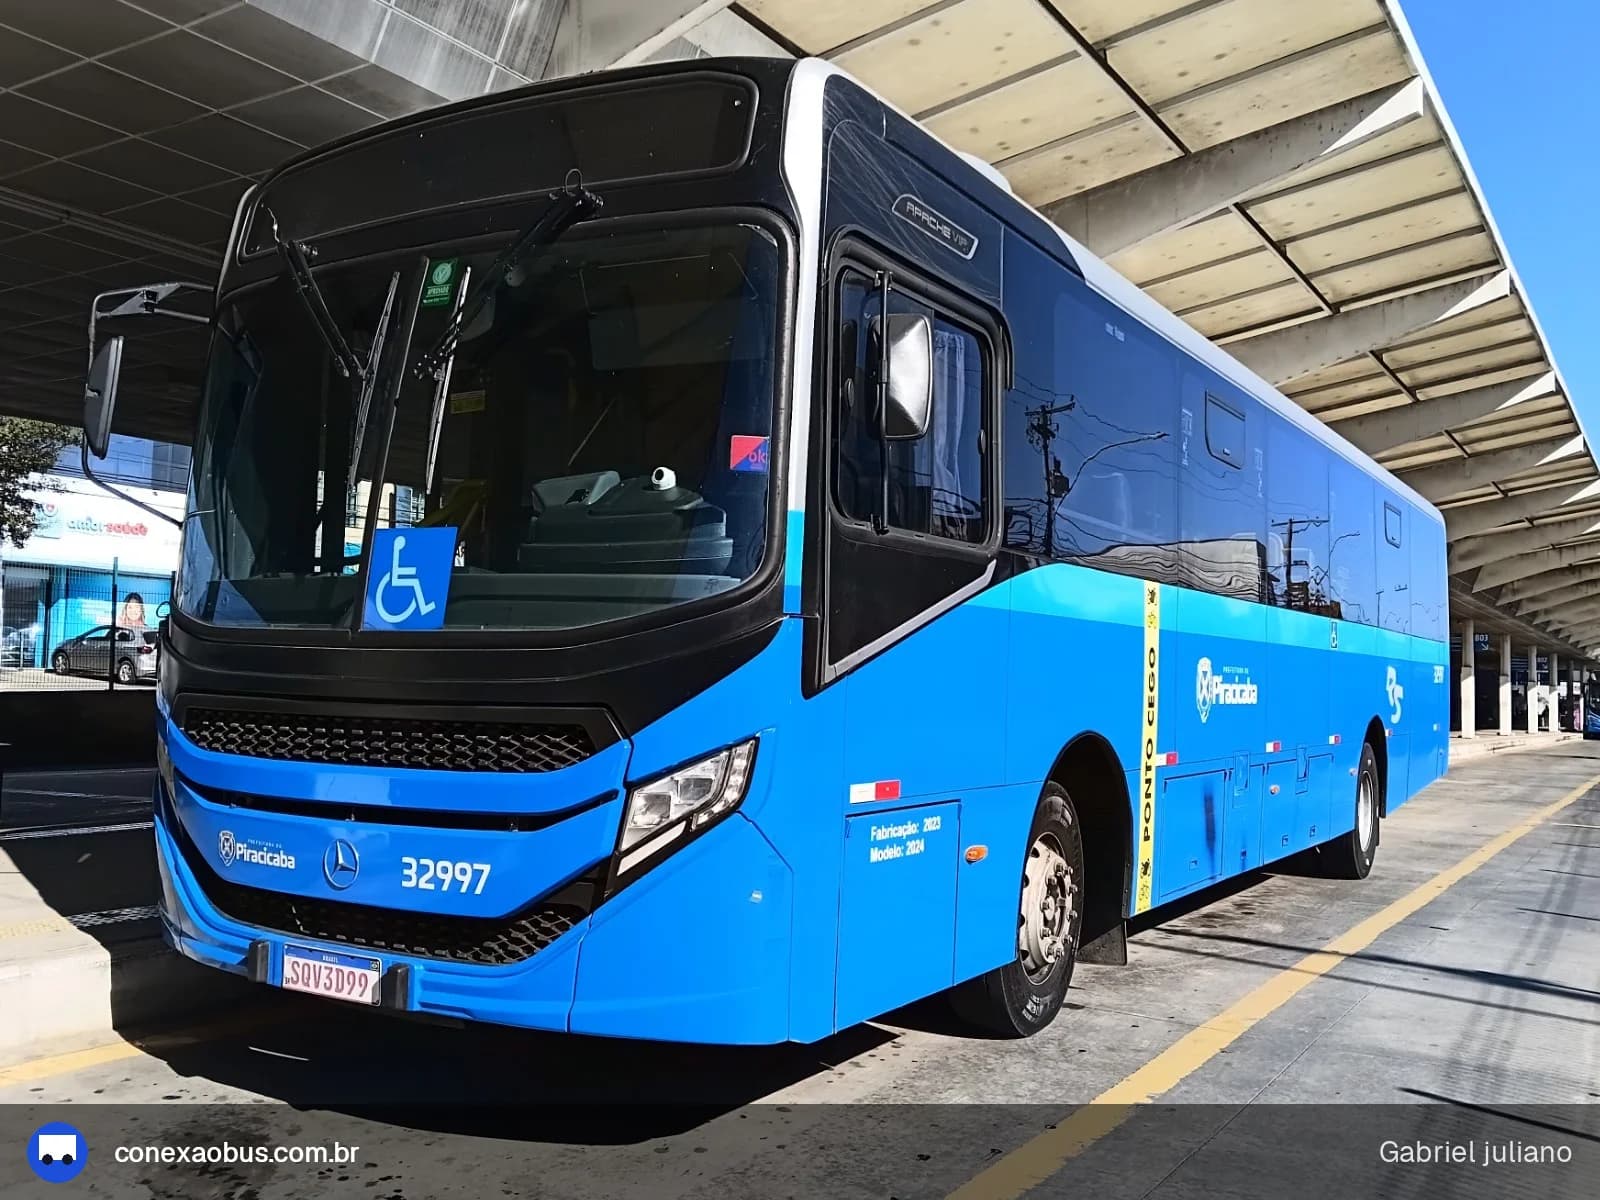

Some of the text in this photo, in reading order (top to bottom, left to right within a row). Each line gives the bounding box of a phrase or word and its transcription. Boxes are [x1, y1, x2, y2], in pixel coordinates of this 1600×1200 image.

[906, 201, 951, 239] APACHE
[1212, 675, 1258, 705] Piracicaba
[1143, 646, 1157, 842] PONTO CEGO
[870, 815, 941, 842] Fabricação: 2023
[236, 842, 296, 870] Piracicaba
[869, 838, 925, 863] Modelo: 2024
[401, 856, 491, 895] 32997
[290, 960, 369, 998] SQV3D99
